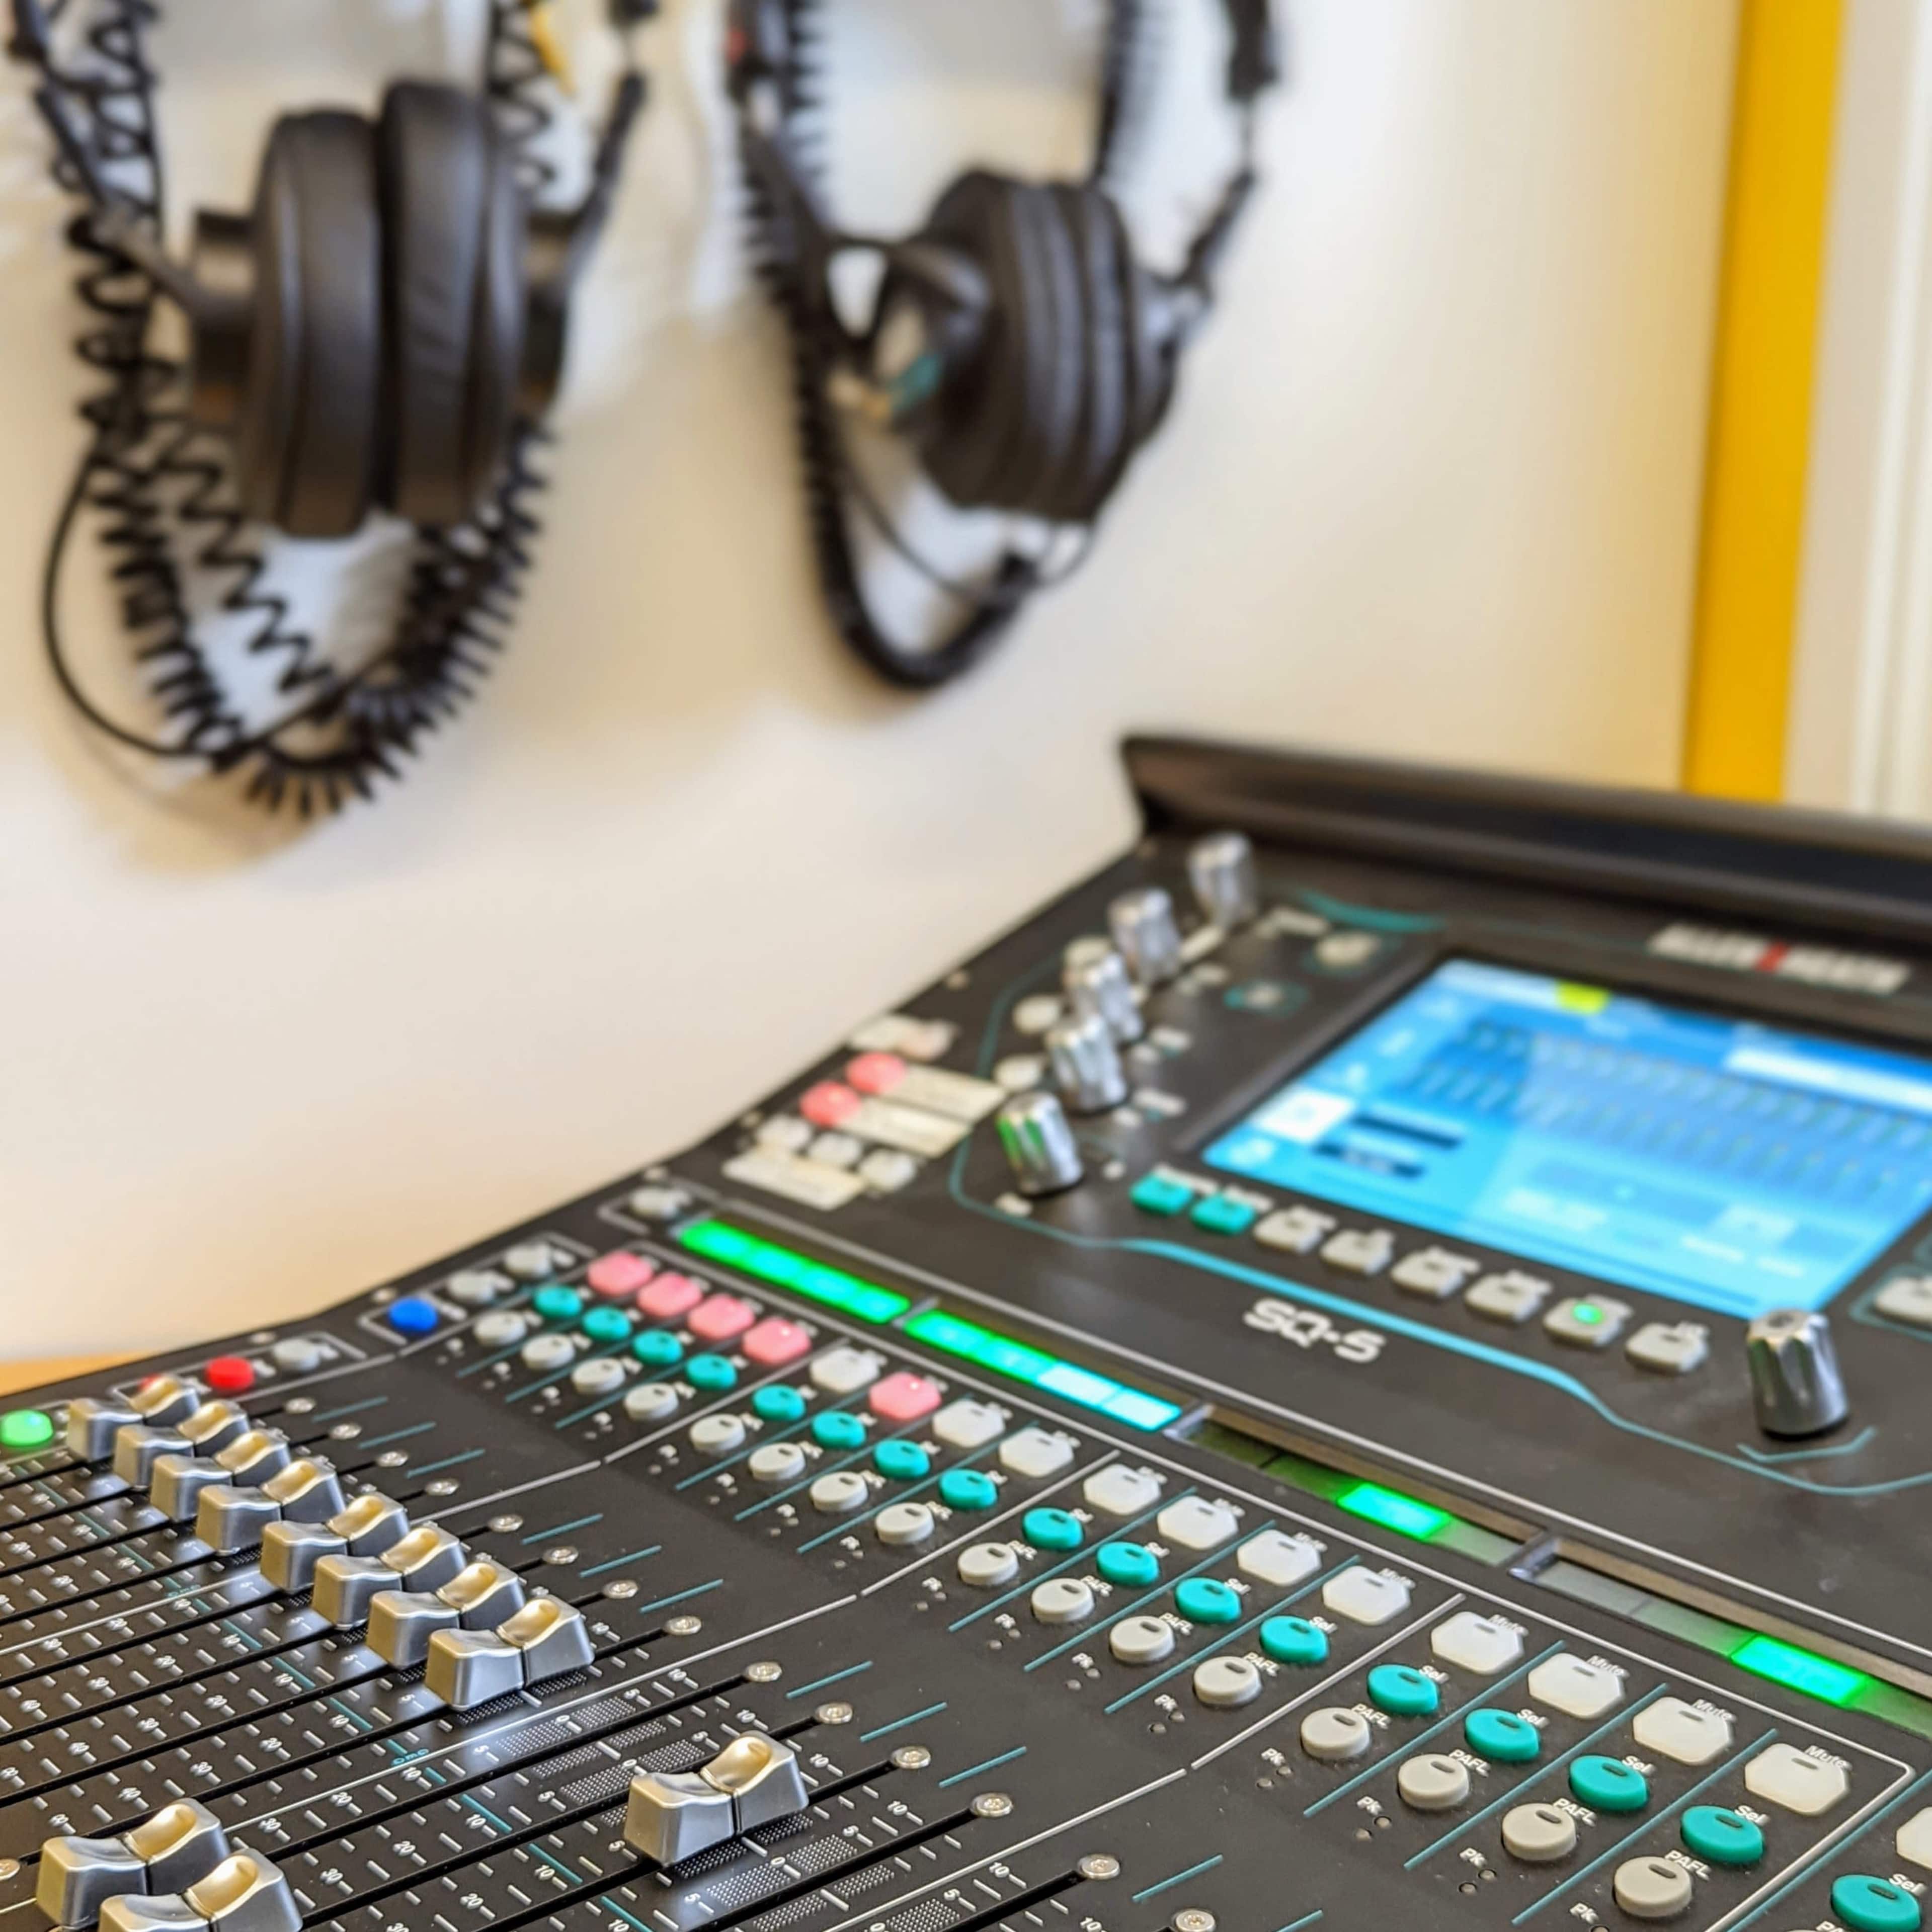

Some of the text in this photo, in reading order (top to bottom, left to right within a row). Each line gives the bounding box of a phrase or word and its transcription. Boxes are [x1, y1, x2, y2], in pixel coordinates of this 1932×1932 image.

[1245, 1652, 1280, 1677] PAFL
[330, 1714, 349, 1728] 10
[556, 1715, 570, 1723] 0
[736, 1709, 756, 1723] 10
[1352, 1704, 1391, 1729] PAFL
[623, 1759, 637, 1767] 0
[810, 1753, 829, 1767] 10
[1450, 1749, 1490, 1777] PAFL
[1622, 1755, 1656, 1775] Sel
[1805, 1745, 1853, 1770] Mute
[403, 1767, 422, 1781] 10
[331, 1792, 352, 1807] 20
[539, 1791, 555, 1803] 5
[888, 1801, 908, 1815] 10
[1554, 1798, 1597, 1826] PAFL
[1735, 1805, 1769, 1826] Sel
[466, 1814, 486, 1829] 10
[393, 1840, 416, 1856] 20
[609, 1840, 625, 1852] 5
[771, 1857, 785, 1867] 0
[1665, 1850, 1711, 1881] PAFL
[321, 1868, 343, 1884] 30
[535, 1865, 555, 1880] 10
[989, 1862, 1010, 1878] 10
[1889, 1873, 1926, 1895] Sel
[460, 1893, 484, 1909] 20
[944, 1888, 960, 1900] 5
[608, 1919, 629, 1932] 10
[870, 1922, 886, 1932] 0
[1080, 1917, 1101, 1932] 10
